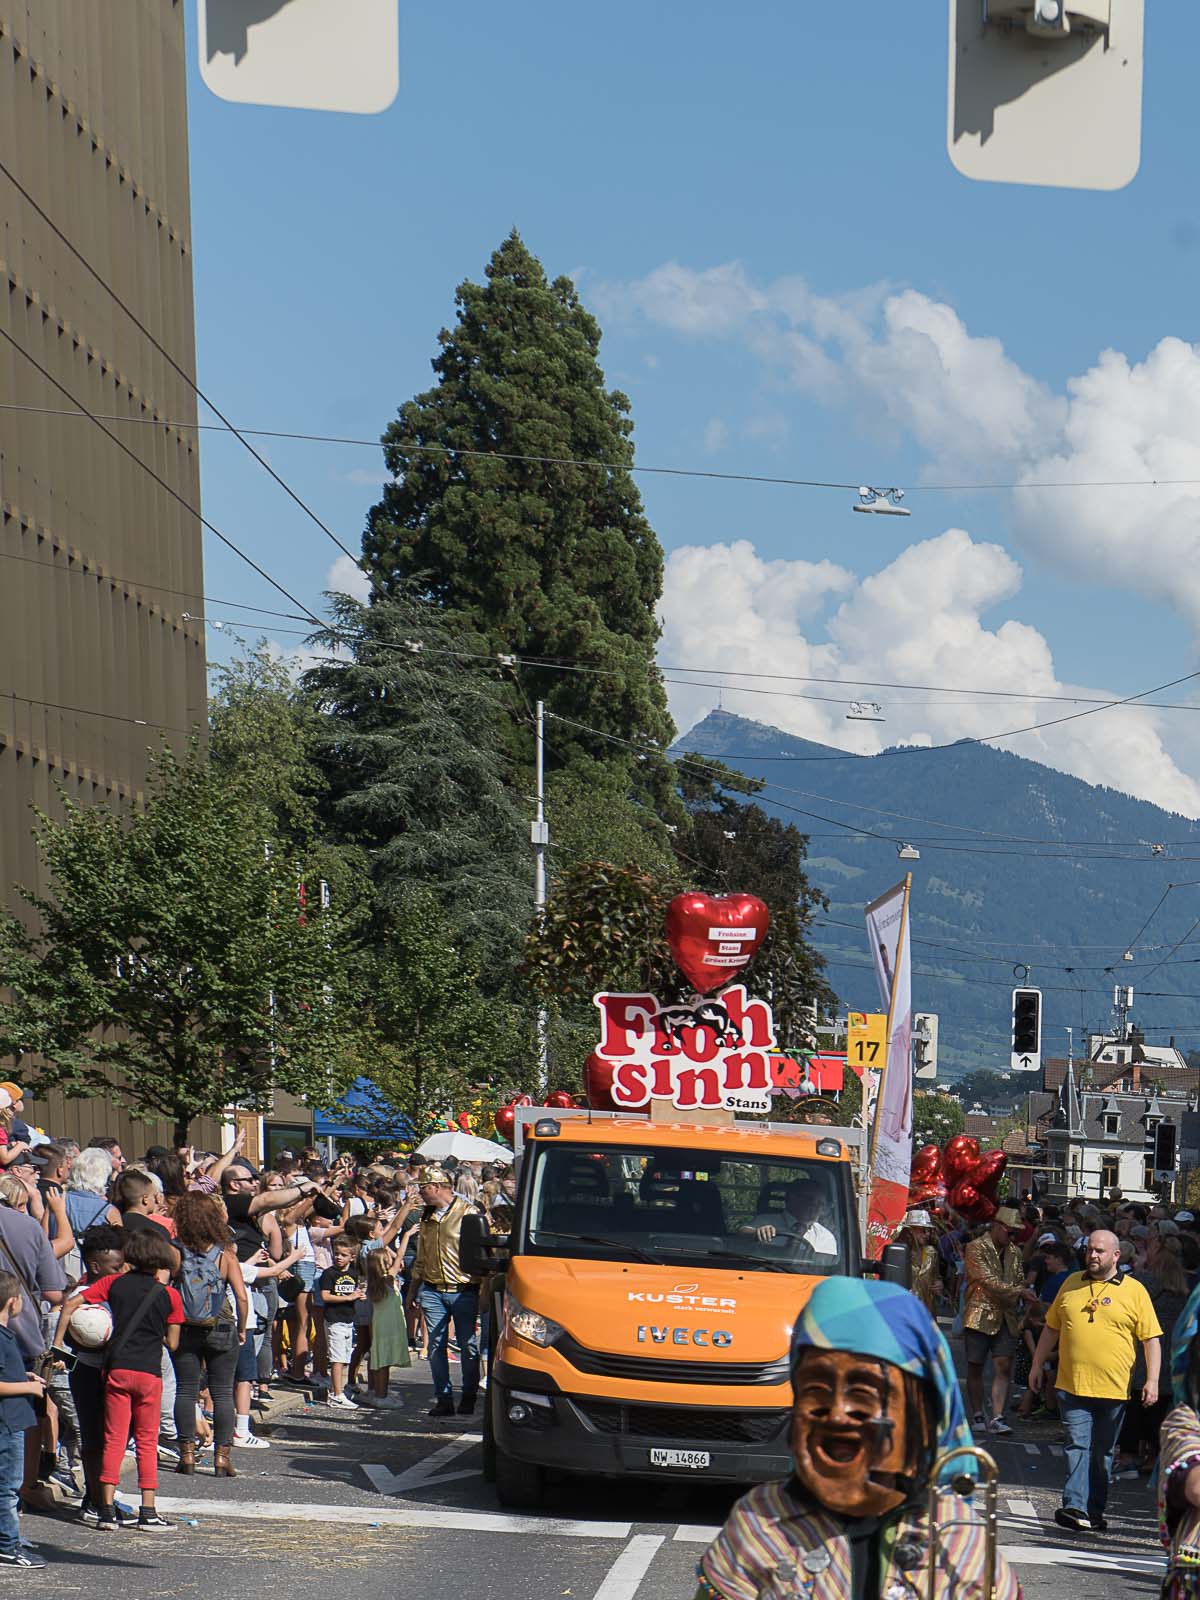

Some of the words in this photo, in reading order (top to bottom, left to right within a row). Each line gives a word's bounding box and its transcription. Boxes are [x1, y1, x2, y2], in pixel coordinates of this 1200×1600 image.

[855, 1040, 880, 1062] 17
[616, 1052, 769, 1106] sinn
[725, 1096, 768, 1110] Stans
[627, 1291, 737, 1308] KUSTER
[637, 1325, 733, 1348] IVECO
